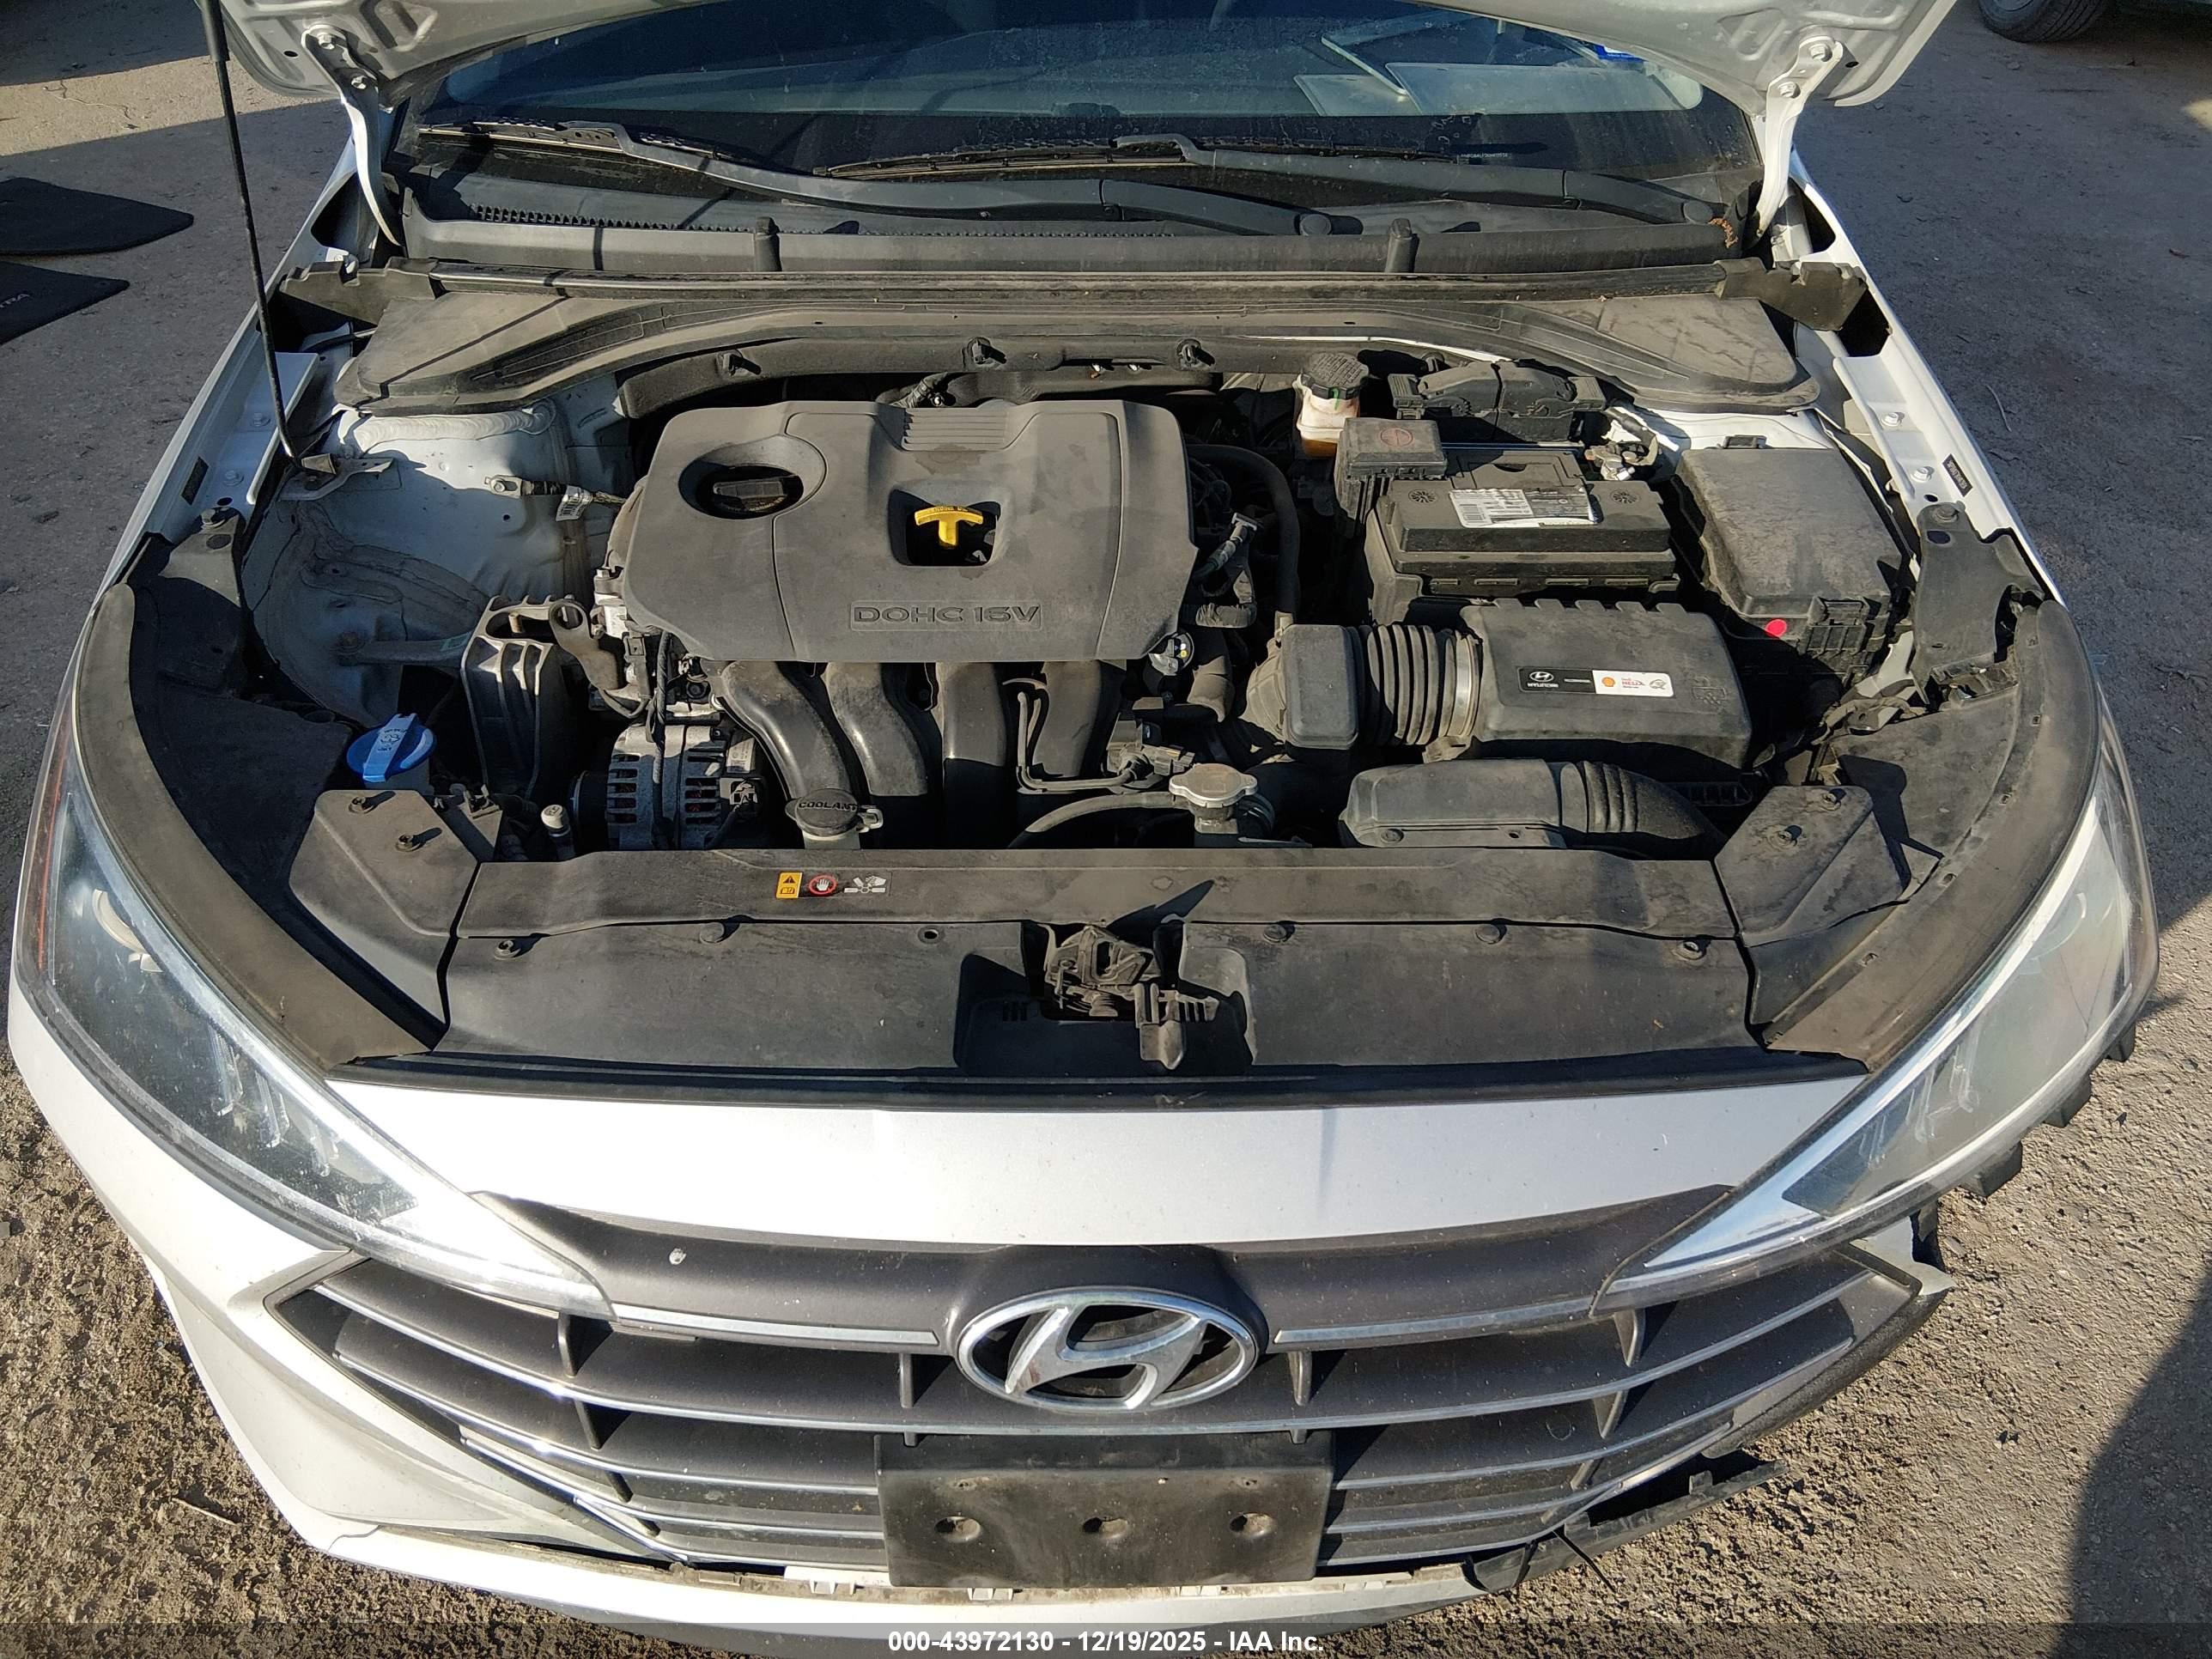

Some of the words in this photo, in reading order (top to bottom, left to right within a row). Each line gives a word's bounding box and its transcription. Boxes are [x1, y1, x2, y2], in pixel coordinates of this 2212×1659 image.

[853, 606, 963, 623] DOHC
[973, 606, 1040, 623] 16V
[798, 800, 858, 812] COOLANT
